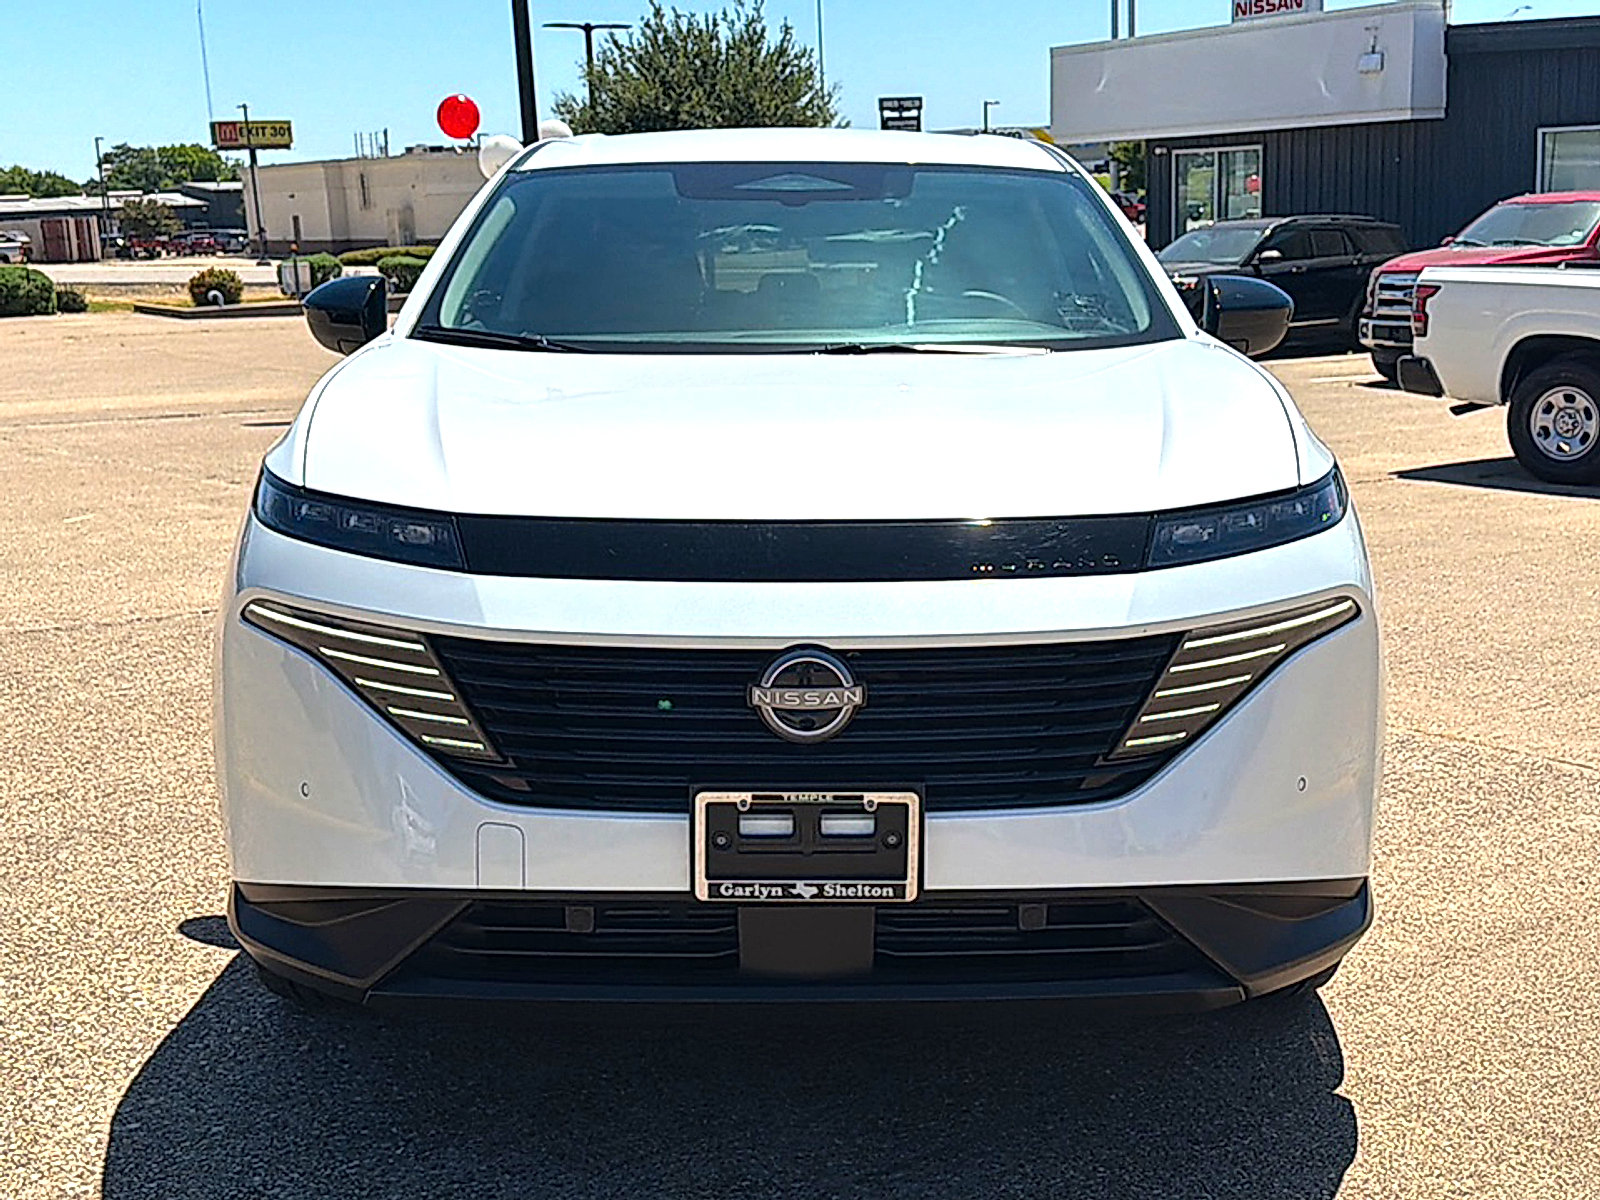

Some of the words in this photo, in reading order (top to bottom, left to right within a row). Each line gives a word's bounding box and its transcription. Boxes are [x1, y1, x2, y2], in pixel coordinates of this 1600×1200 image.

[1235, 0, 1303, 17] NISSAN
[239, 126, 267, 138] EXIT
[754, 689, 860, 706] NISSAN
[783, 794, 834, 803] TEMPLE
[719, 883, 783, 900] Garlyn
[822, 882, 895, 898] Shelton
